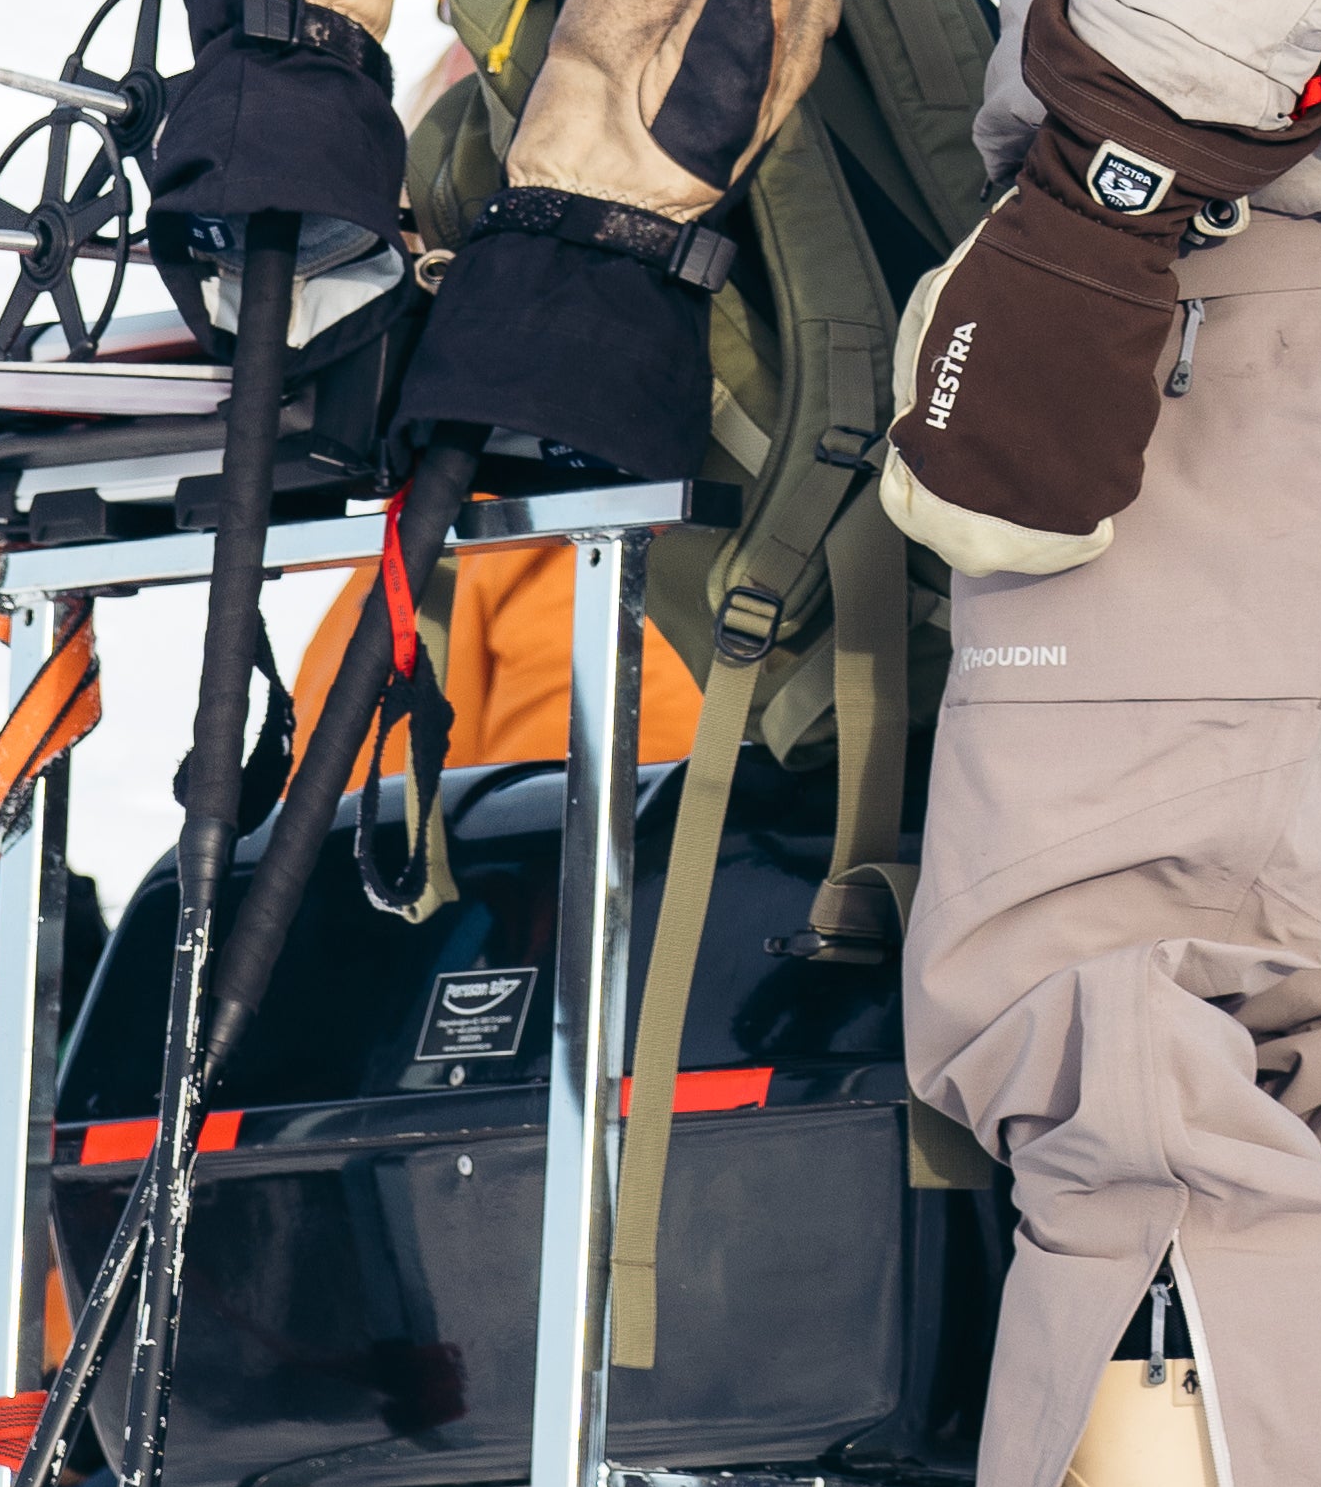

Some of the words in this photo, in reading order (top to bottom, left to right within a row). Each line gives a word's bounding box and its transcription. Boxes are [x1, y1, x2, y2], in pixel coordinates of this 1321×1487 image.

[1107, 158, 1152, 187] HESTRA
[925, 321, 977, 430] HESTRA
[970, 645, 1068, 669] HOUDINI
